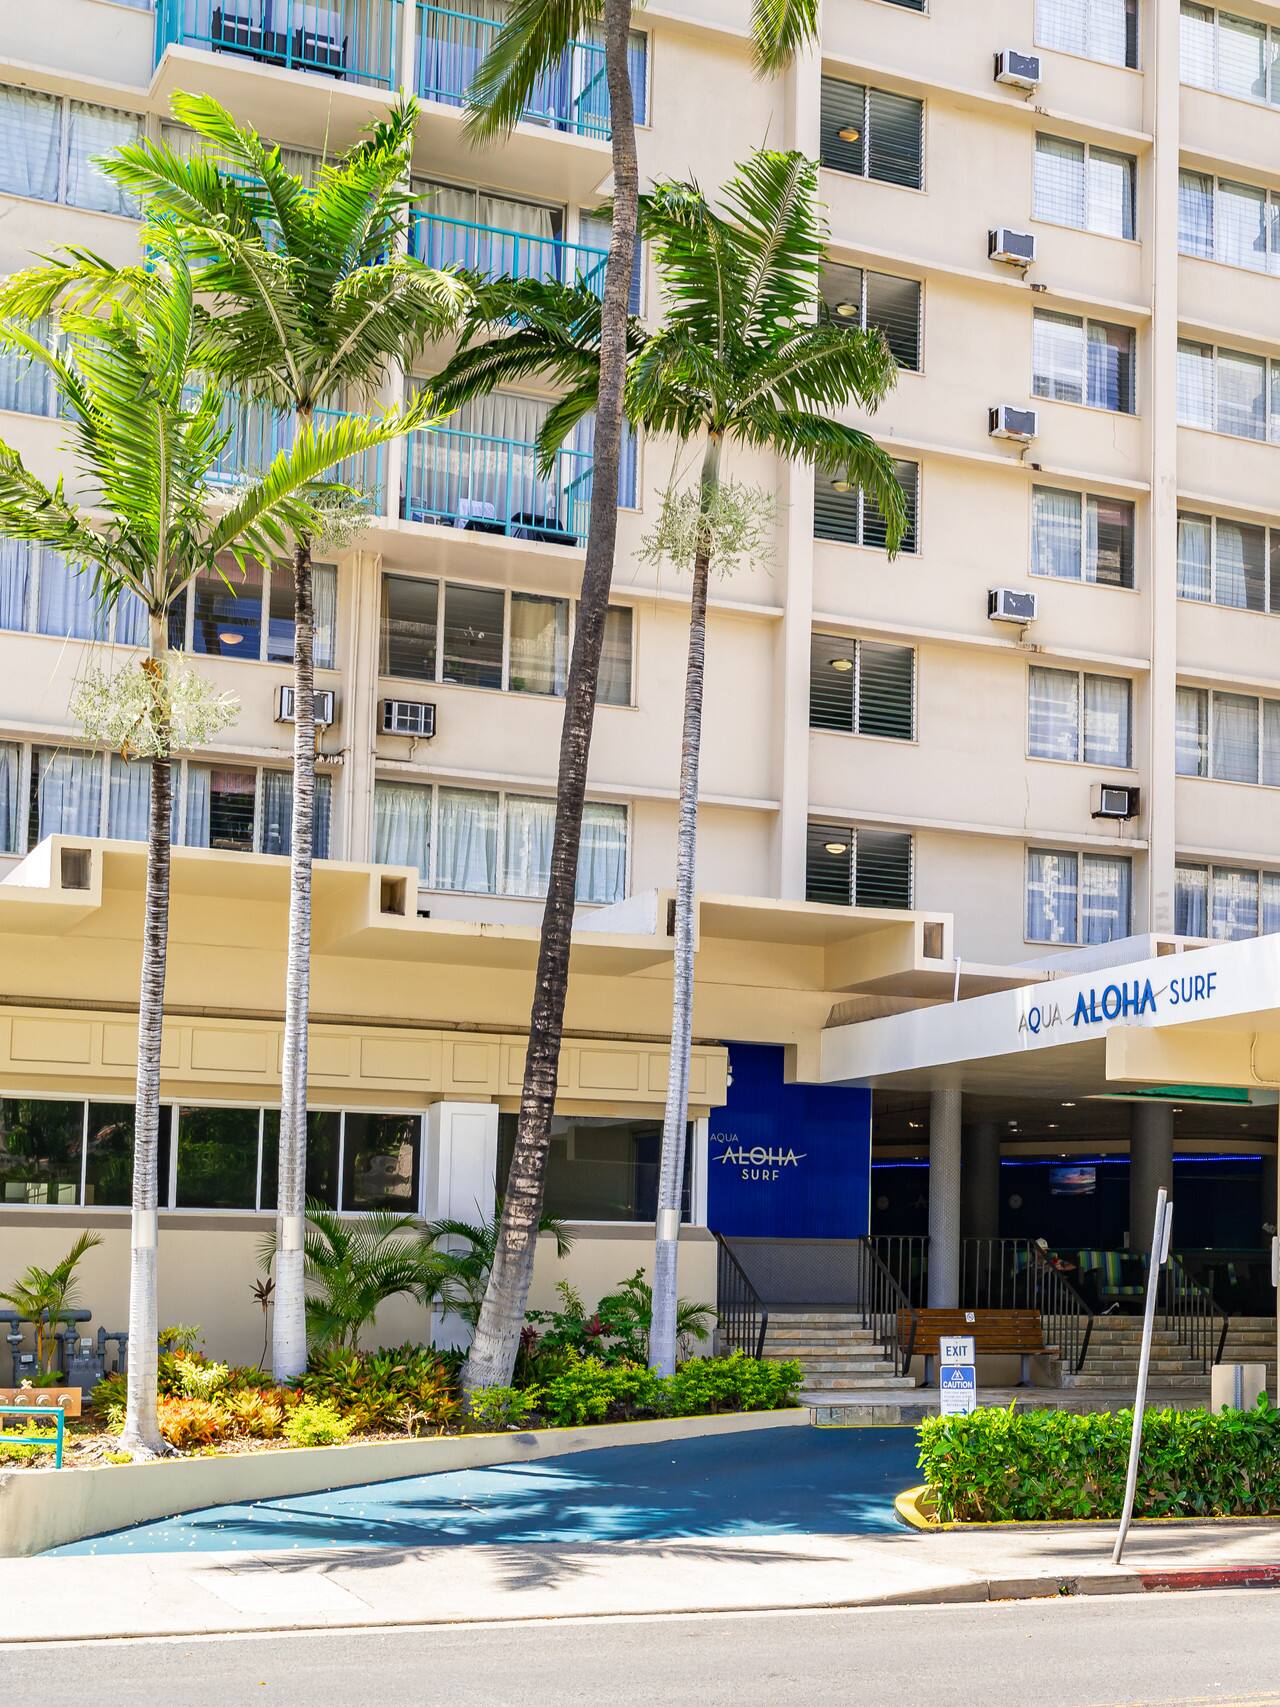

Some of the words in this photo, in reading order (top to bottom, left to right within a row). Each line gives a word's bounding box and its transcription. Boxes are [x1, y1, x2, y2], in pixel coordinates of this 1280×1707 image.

[1018, 1002, 1063, 1033] AQUA
[1073, 978, 1156, 1026] ALOHA
[1169, 972, 1217, 1005] SURF
[710, 1132, 739, 1143] AQUA
[722, 1146, 798, 1166] ALOHA
[742, 1168, 780, 1180] SURF
[946, 1345, 968, 1356] EXIT
